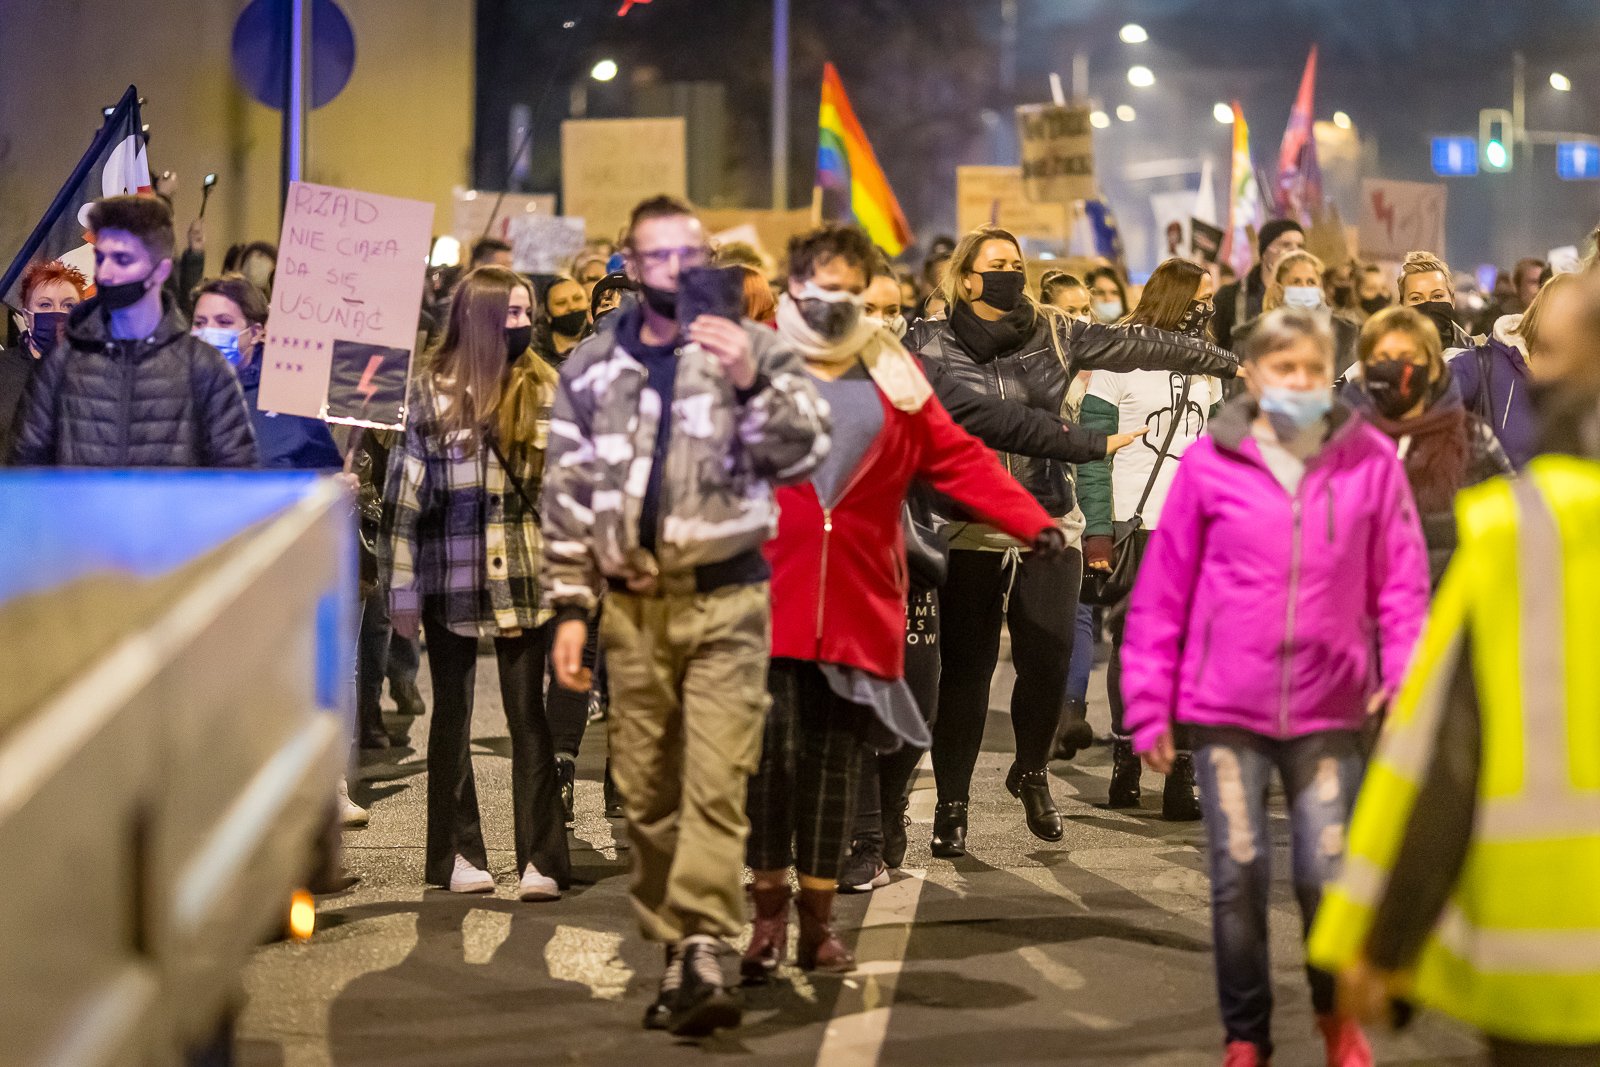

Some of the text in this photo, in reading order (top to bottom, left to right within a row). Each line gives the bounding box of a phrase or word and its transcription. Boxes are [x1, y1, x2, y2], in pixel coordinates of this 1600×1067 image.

[294, 185, 378, 227] RZĄD
[289, 227, 325, 251] NIE
[285, 257, 359, 294] DA SIĘ
[904, 605, 936, 616] IME
[905, 619, 925, 631] IS
[906, 633, 936, 645] OW
